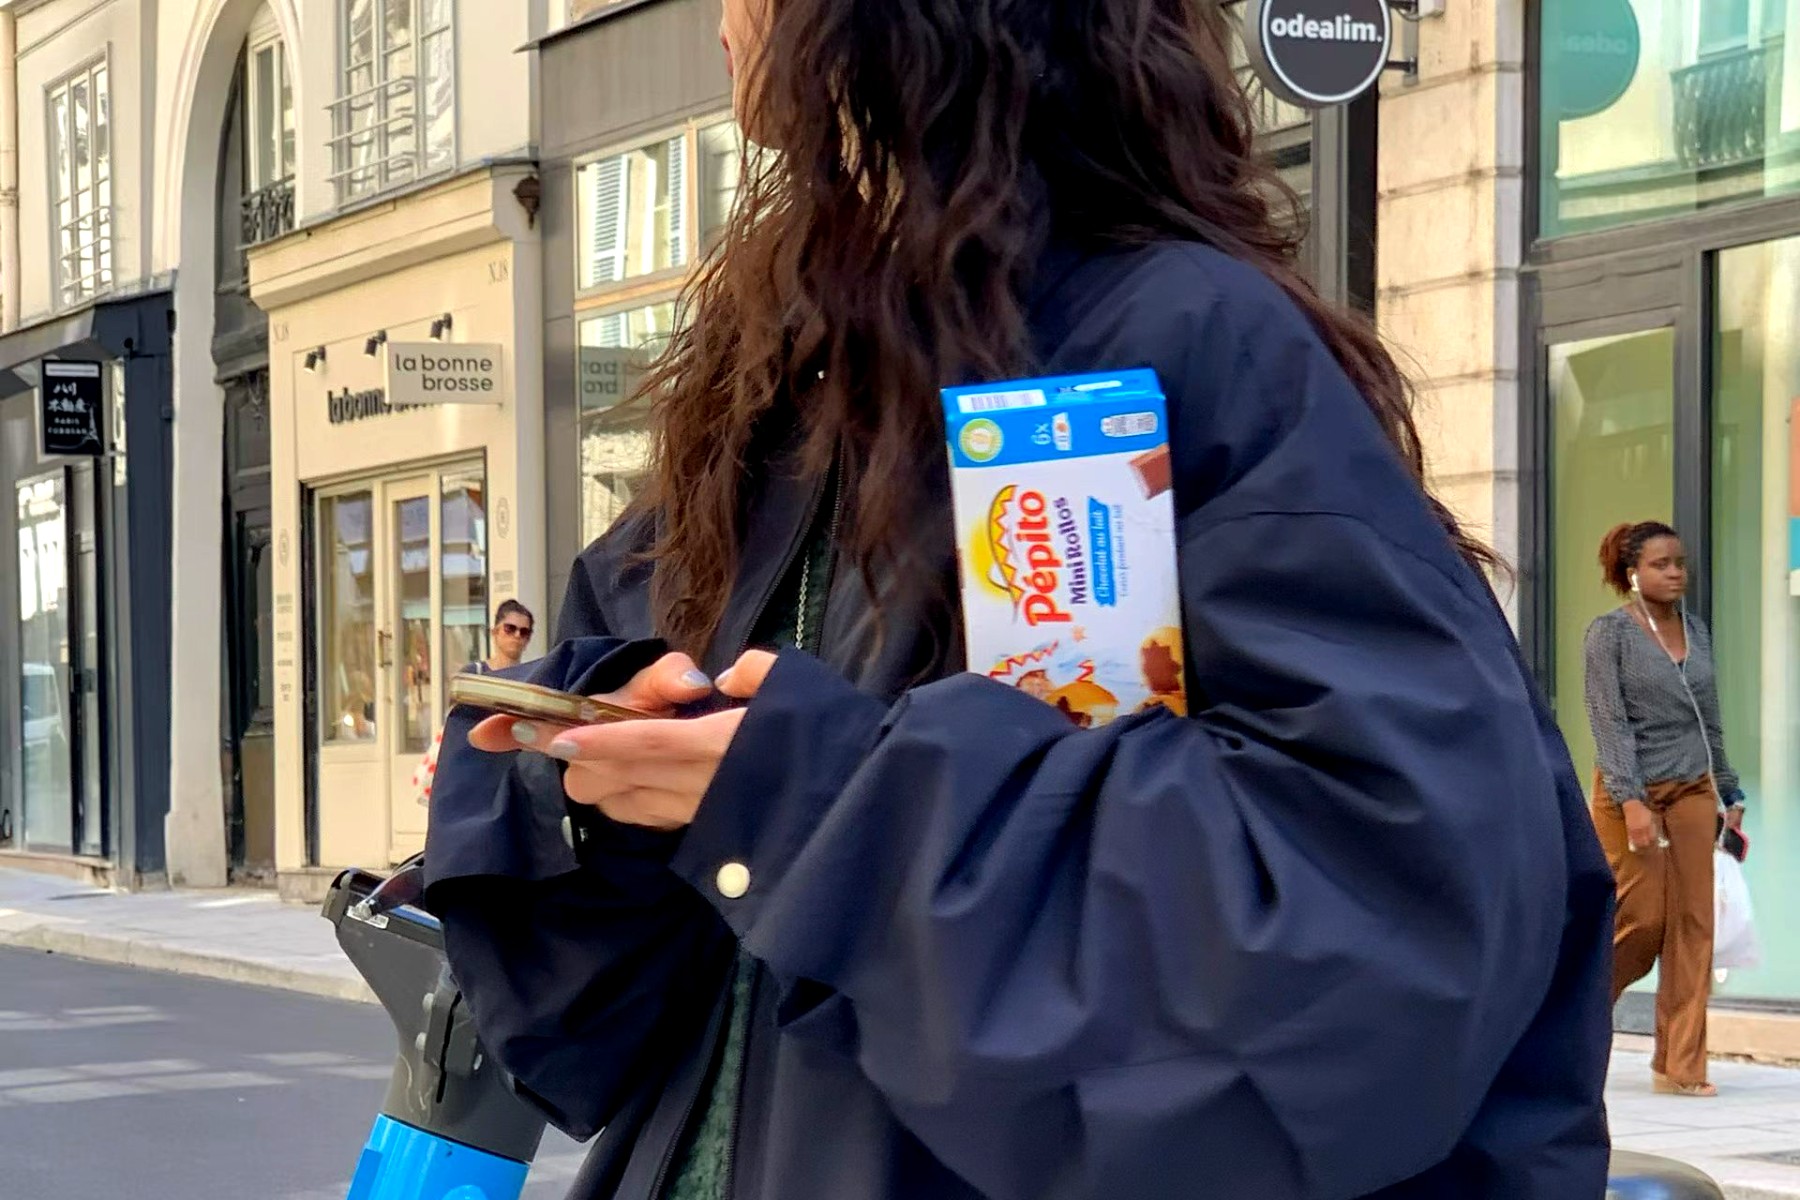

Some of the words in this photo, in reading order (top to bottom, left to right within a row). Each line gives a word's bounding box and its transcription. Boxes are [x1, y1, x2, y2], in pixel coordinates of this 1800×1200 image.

[1270, 13, 1383, 42] odealim.
[396, 353, 416, 372] la
[421, 354, 493, 372] bonne
[422, 374, 494, 392] brosse
[1053, 497, 1082, 560] Rollos
[1015, 490, 1073, 627] Pépito
[1066, 560, 1087, 605] Mini
